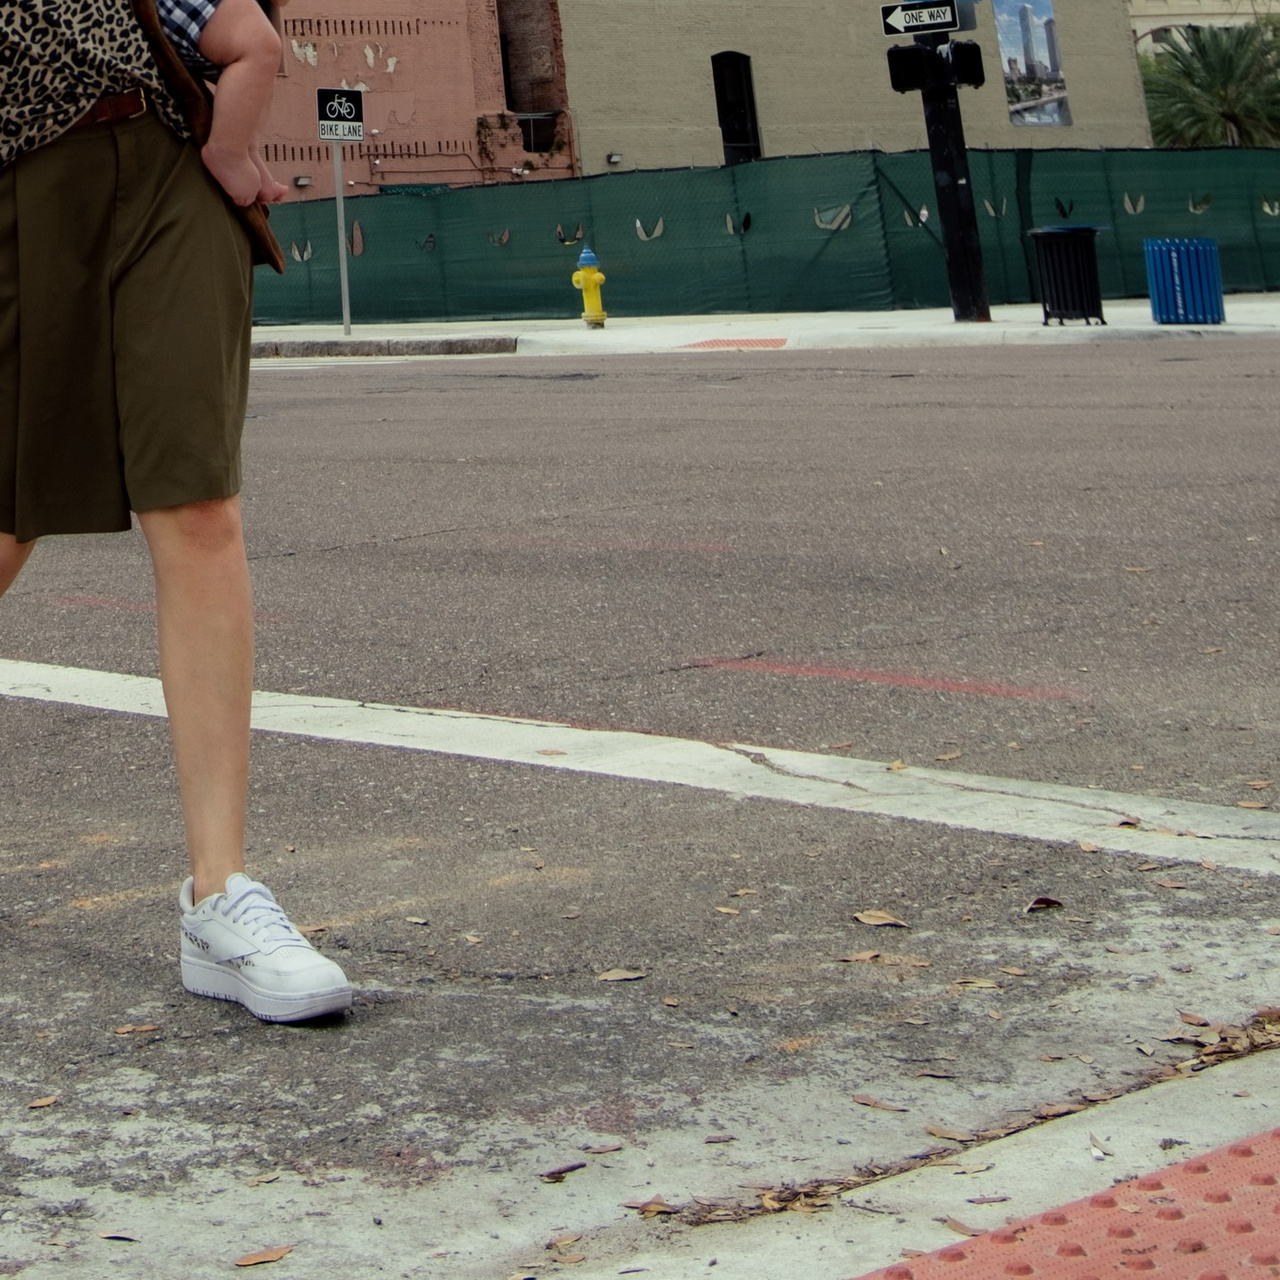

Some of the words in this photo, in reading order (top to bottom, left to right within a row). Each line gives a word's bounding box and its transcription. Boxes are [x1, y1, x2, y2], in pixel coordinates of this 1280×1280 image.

[904, 11, 925, 25] ONE
[928, 8, 948, 21] WAY
[321, 124, 339, 136] BIKE
[342, 125, 362, 137] LANE
